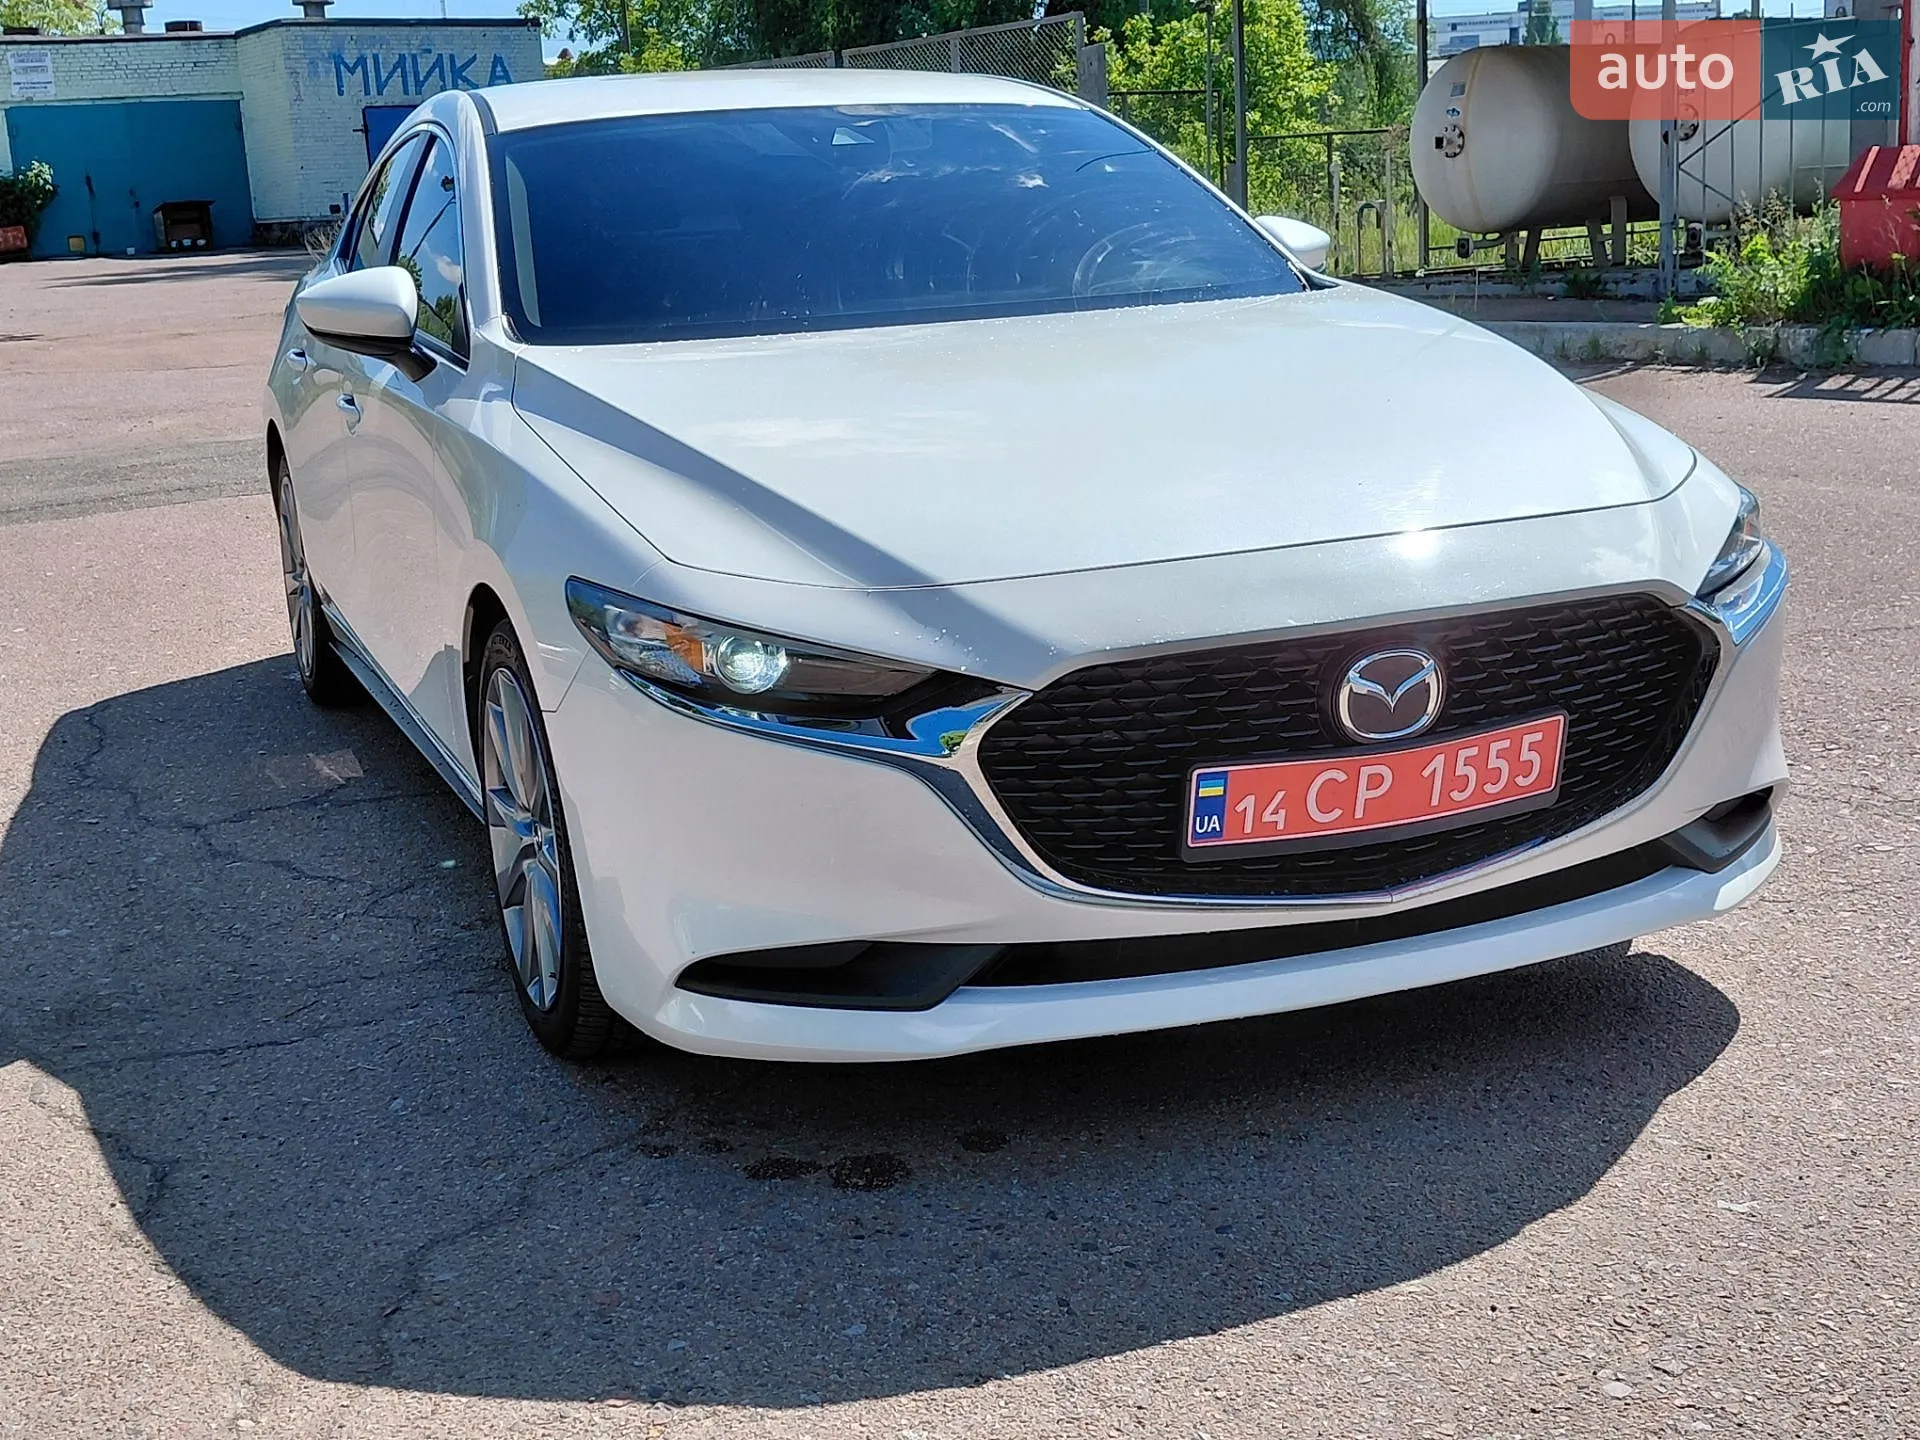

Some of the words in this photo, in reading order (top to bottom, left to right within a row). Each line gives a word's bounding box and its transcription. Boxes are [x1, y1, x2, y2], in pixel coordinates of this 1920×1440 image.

[333, 49, 513, 97] МИЙКА
[1234, 790, 1287, 834] 14
[1305, 764, 1394, 824] CP
[1420, 731, 1544, 807] 1555
[1195, 815, 1221, 833] UA
